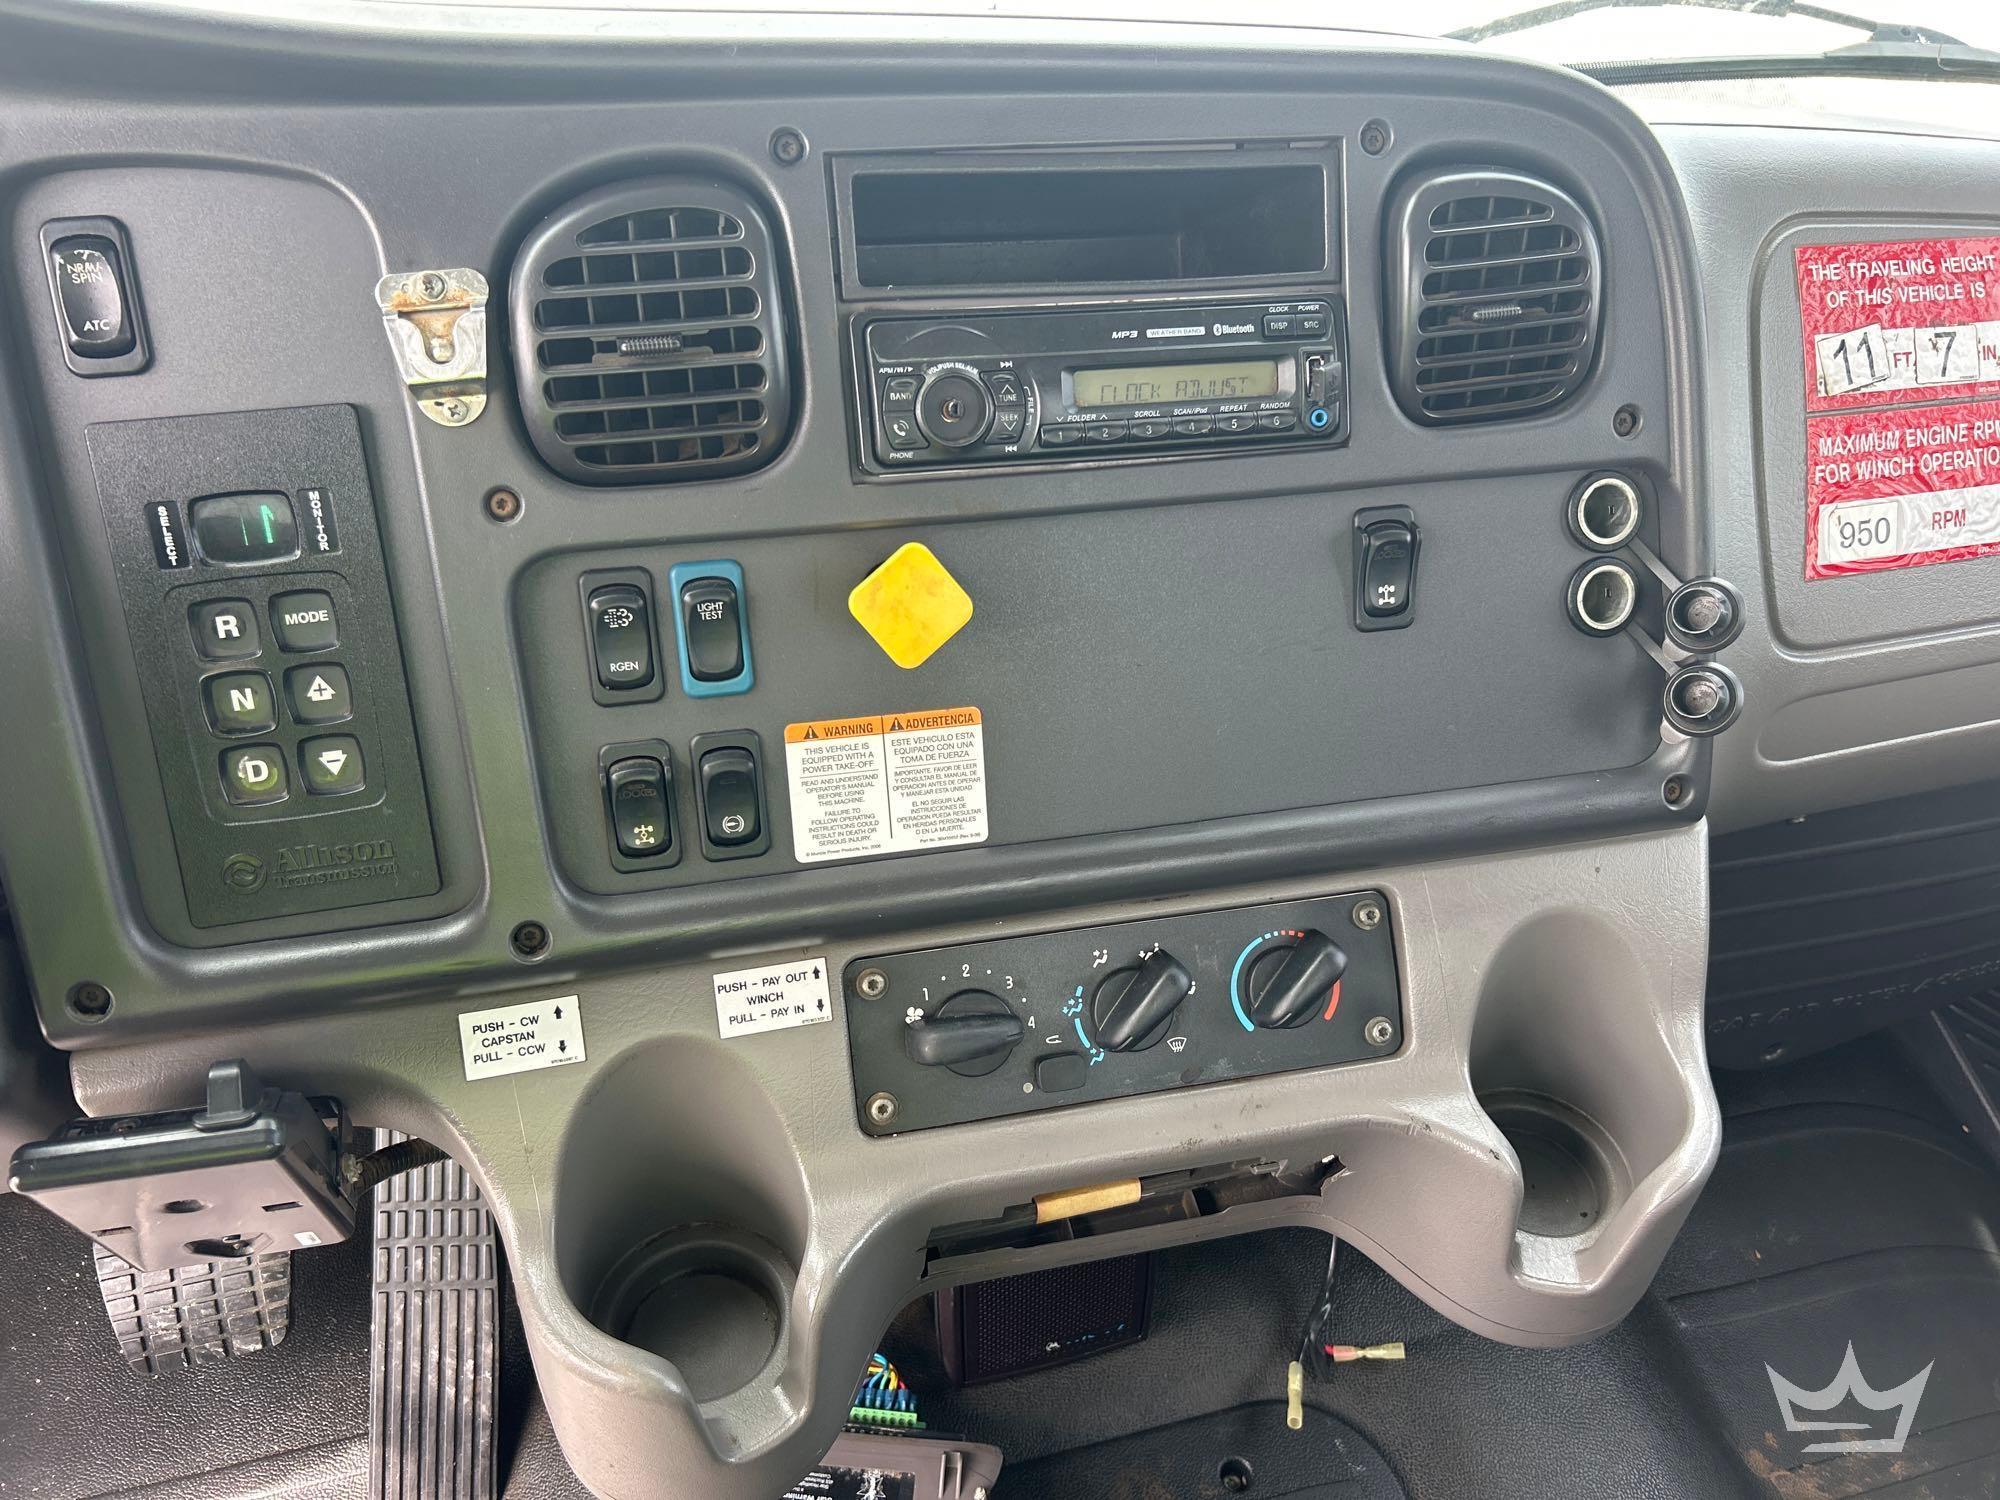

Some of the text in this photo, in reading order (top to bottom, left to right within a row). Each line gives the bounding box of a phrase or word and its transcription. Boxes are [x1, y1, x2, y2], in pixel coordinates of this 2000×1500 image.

[1808, 255, 1995, 281] THE TRAVELING HEIGHT
[71, 272, 103, 284] SPIN
[1826, 281, 1986, 308] OF THIS VEHICLE IS
[83, 320, 110, 331] ATC
[1222, 323, 1254, 334] Bluetooth
[1270, 322, 1288, 330] DISP
[1303, 321, 1319, 329] SRC
[1111, 330, 1138, 339] MP3
[1150, 327, 1201, 337] WEATHER BAND
[1833, 331, 1876, 386] 11
[1934, 331, 1956, 378] 7
[889, 392, 911, 400] BAND
[1101, 377, 1248, 404] CLOCK ADJUST
[999, 394, 1017, 402] TUNE
[1173, 407, 1207, 415] SCAN/iPod
[1219, 404, 1248, 412] REPEAT
[1260, 401, 1290, 410] RANDOM
[1067, 413, 1096, 422] FOLDER
[1134, 409, 1161, 417] SCROLL
[1188, 422, 1195, 431] 4
[1231, 418, 1238, 429] 5
[1273, 416, 1280, 426] 6
[1102, 428, 1109, 438] 2
[1145, 425, 1152, 435] 3
[1819, 430, 1899, 457] MAXIMUM
[1905, 423, 1968, 449] ENGINE
[890, 451, 914, 459] PHONE
[1815, 445, 2000, 485] FOR WINCH OPERATIO
[308, 491, 329, 551] MONITOR
[1839, 508, 1966, 549] 950 RPM
[157, 505, 177, 566] SELECT
[696, 601, 724, 612] LIGHT
[285, 610, 329, 625] MODE
[700, 610, 723, 621] TEST
[215, 615, 240, 638] R
[609, 661, 639, 672] RGEN
[230, 688, 255, 711] N
[906, 713, 974, 730] ADVERTENCIA
[824, 723, 873, 738] WARNING
[891, 732, 975, 746] ESTE VEHICULO ESTA
[805, 742, 870, 755] THIS VEHICLE IS
[894, 741, 974, 755] EQUIPADO CON UNA
[802, 754, 843, 765] EQUIPPED
[845, 752, 866, 760] WITH
[900, 755, 924, 763] TOMA
[938, 750, 969, 760] FUERZA
[246, 760, 269, 782] D
[802, 760, 874, 774] POWER TAKE-OFF
[835, 773, 878, 783] UNDERSTAND
[892, 782, 927, 791] OPERACION
[927, 780, 946, 788] ANTES
[956, 776, 980, 784] OPERAR
[900, 775, 934, 783] CONSULTAR
[944, 771, 968, 779] MANUAL
[805, 781, 874, 794] OPERATOR'S MANUAL
[906, 789, 933, 797] MANEJAR
[817, 789, 865, 800] BEFORE USING
[824, 809, 850, 817] FAILURE
[897, 814, 931, 823] OPERACION
[952, 808, 981, 817] RESULTAR
[910, 804, 957, 814] INSTRUCCIONES
[811, 813, 876, 826] FOLLOW OPERATING
[912, 820, 937, 828] HERIDAS
[938, 816, 977, 825] PERSONALES
[808, 823, 855, 833] INSTRUCTIONS
[812, 831, 836, 840] RESULT
[845, 828, 866, 836] DEATH
[819, 838, 846, 846] SERIOUS
[272, 840, 395, 873] Allison
[962, 963, 970, 977] 2
[717, 971, 808, 994] PUSH PAY OUT
[1005, 975, 1014, 989] 3
[746, 992, 784, 1006] WINCH
[922, 987, 929, 1001] 1
[729, 1004, 805, 1025] PULL PAY IN
[472, 1015, 540, 1035] PUSH CW
[1027, 1015, 1036, 1029] 4
[481, 1030, 535, 1048] CAPSTAN
[473, 1043, 546, 1064] PULL CCW
